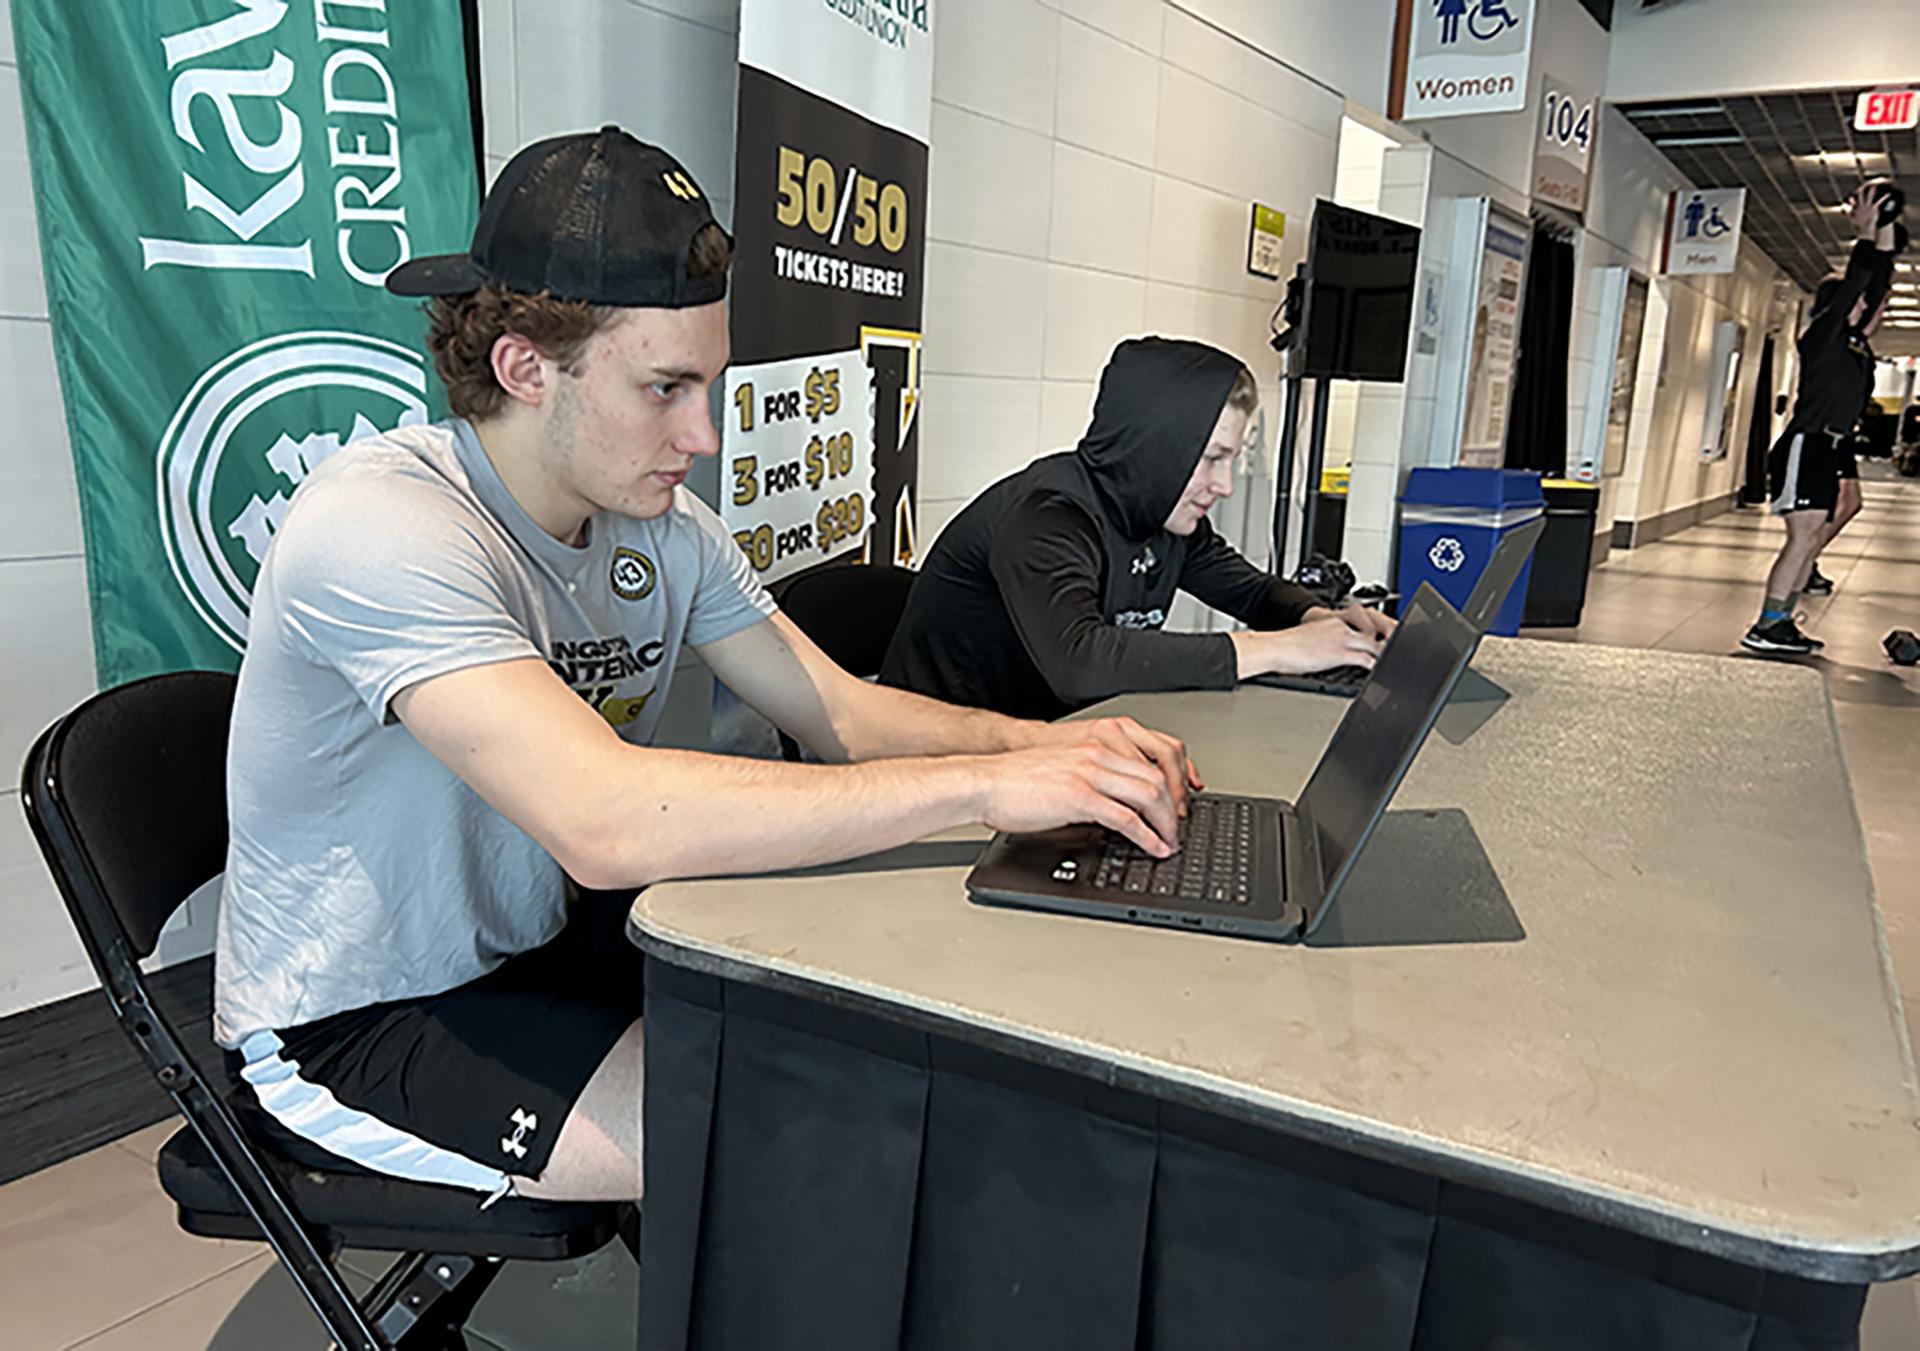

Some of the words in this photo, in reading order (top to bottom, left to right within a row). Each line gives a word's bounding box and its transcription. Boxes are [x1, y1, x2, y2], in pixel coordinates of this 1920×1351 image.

[1416, 76, 1514, 99] Women
[1865, 92, 1914, 125] EXIT
[1546, 96, 1590, 148] 104
[777, 146, 907, 252] 50/50
[775, 246, 849, 288] TICKETS
[851, 263, 904, 297] HERE!
[734, 382, 754, 432] 1
[764, 390, 800, 424] FOR
[805, 366, 840, 424] $5
[733, 455, 758, 506] 3
[764, 461, 801, 496] FOR
[805, 431, 854, 491] $10
[776, 523, 814, 560] FOR
[816, 492, 865, 554] $20
